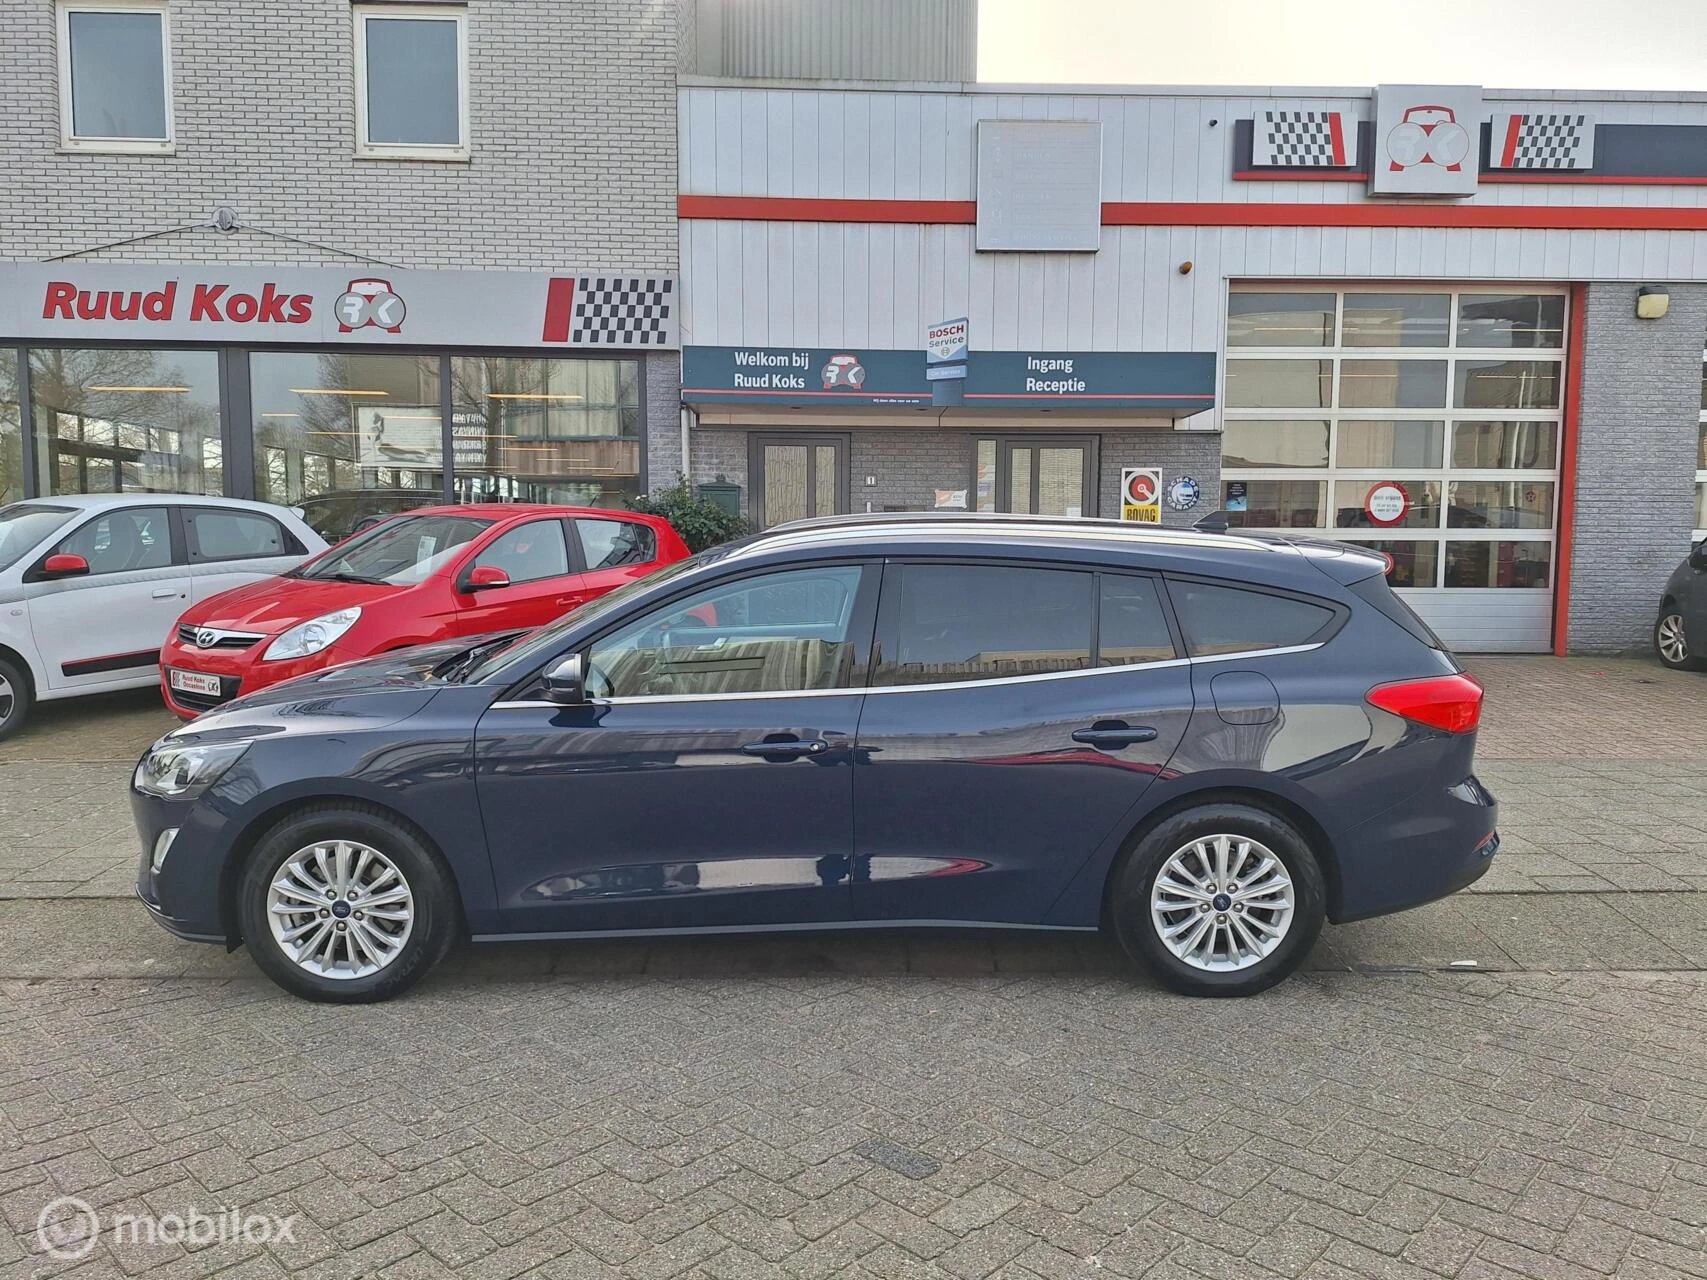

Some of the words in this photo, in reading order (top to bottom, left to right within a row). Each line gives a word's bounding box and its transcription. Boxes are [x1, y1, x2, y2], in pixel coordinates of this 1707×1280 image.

[42, 281, 177, 321] Ruud
[189, 283, 313, 324] Koks
[929, 324, 964, 339] BOSCH
[929, 336, 965, 348] Service
[734, 351, 789, 367] Welkom
[792, 352, 810, 370] bij
[1027, 356, 1074, 374] Ingang
[734, 373, 769, 388] Ruud
[772, 374, 806, 389] Koks
[1026, 377, 1086, 395] Receptie
